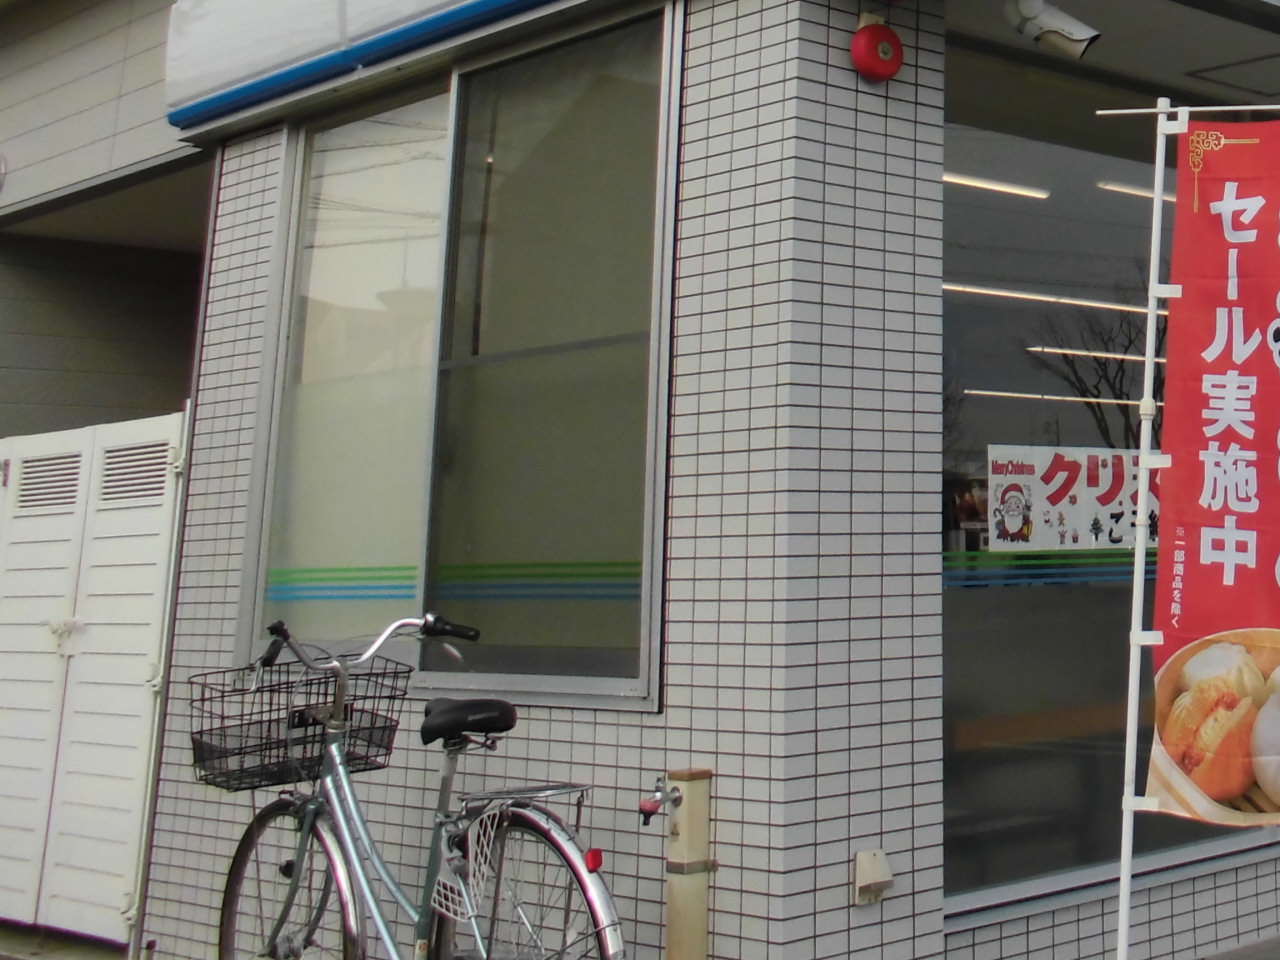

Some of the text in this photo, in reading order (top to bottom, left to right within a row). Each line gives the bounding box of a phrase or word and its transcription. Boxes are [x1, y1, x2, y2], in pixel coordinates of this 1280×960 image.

[1199, 181, 1266, 586] セール実施中
